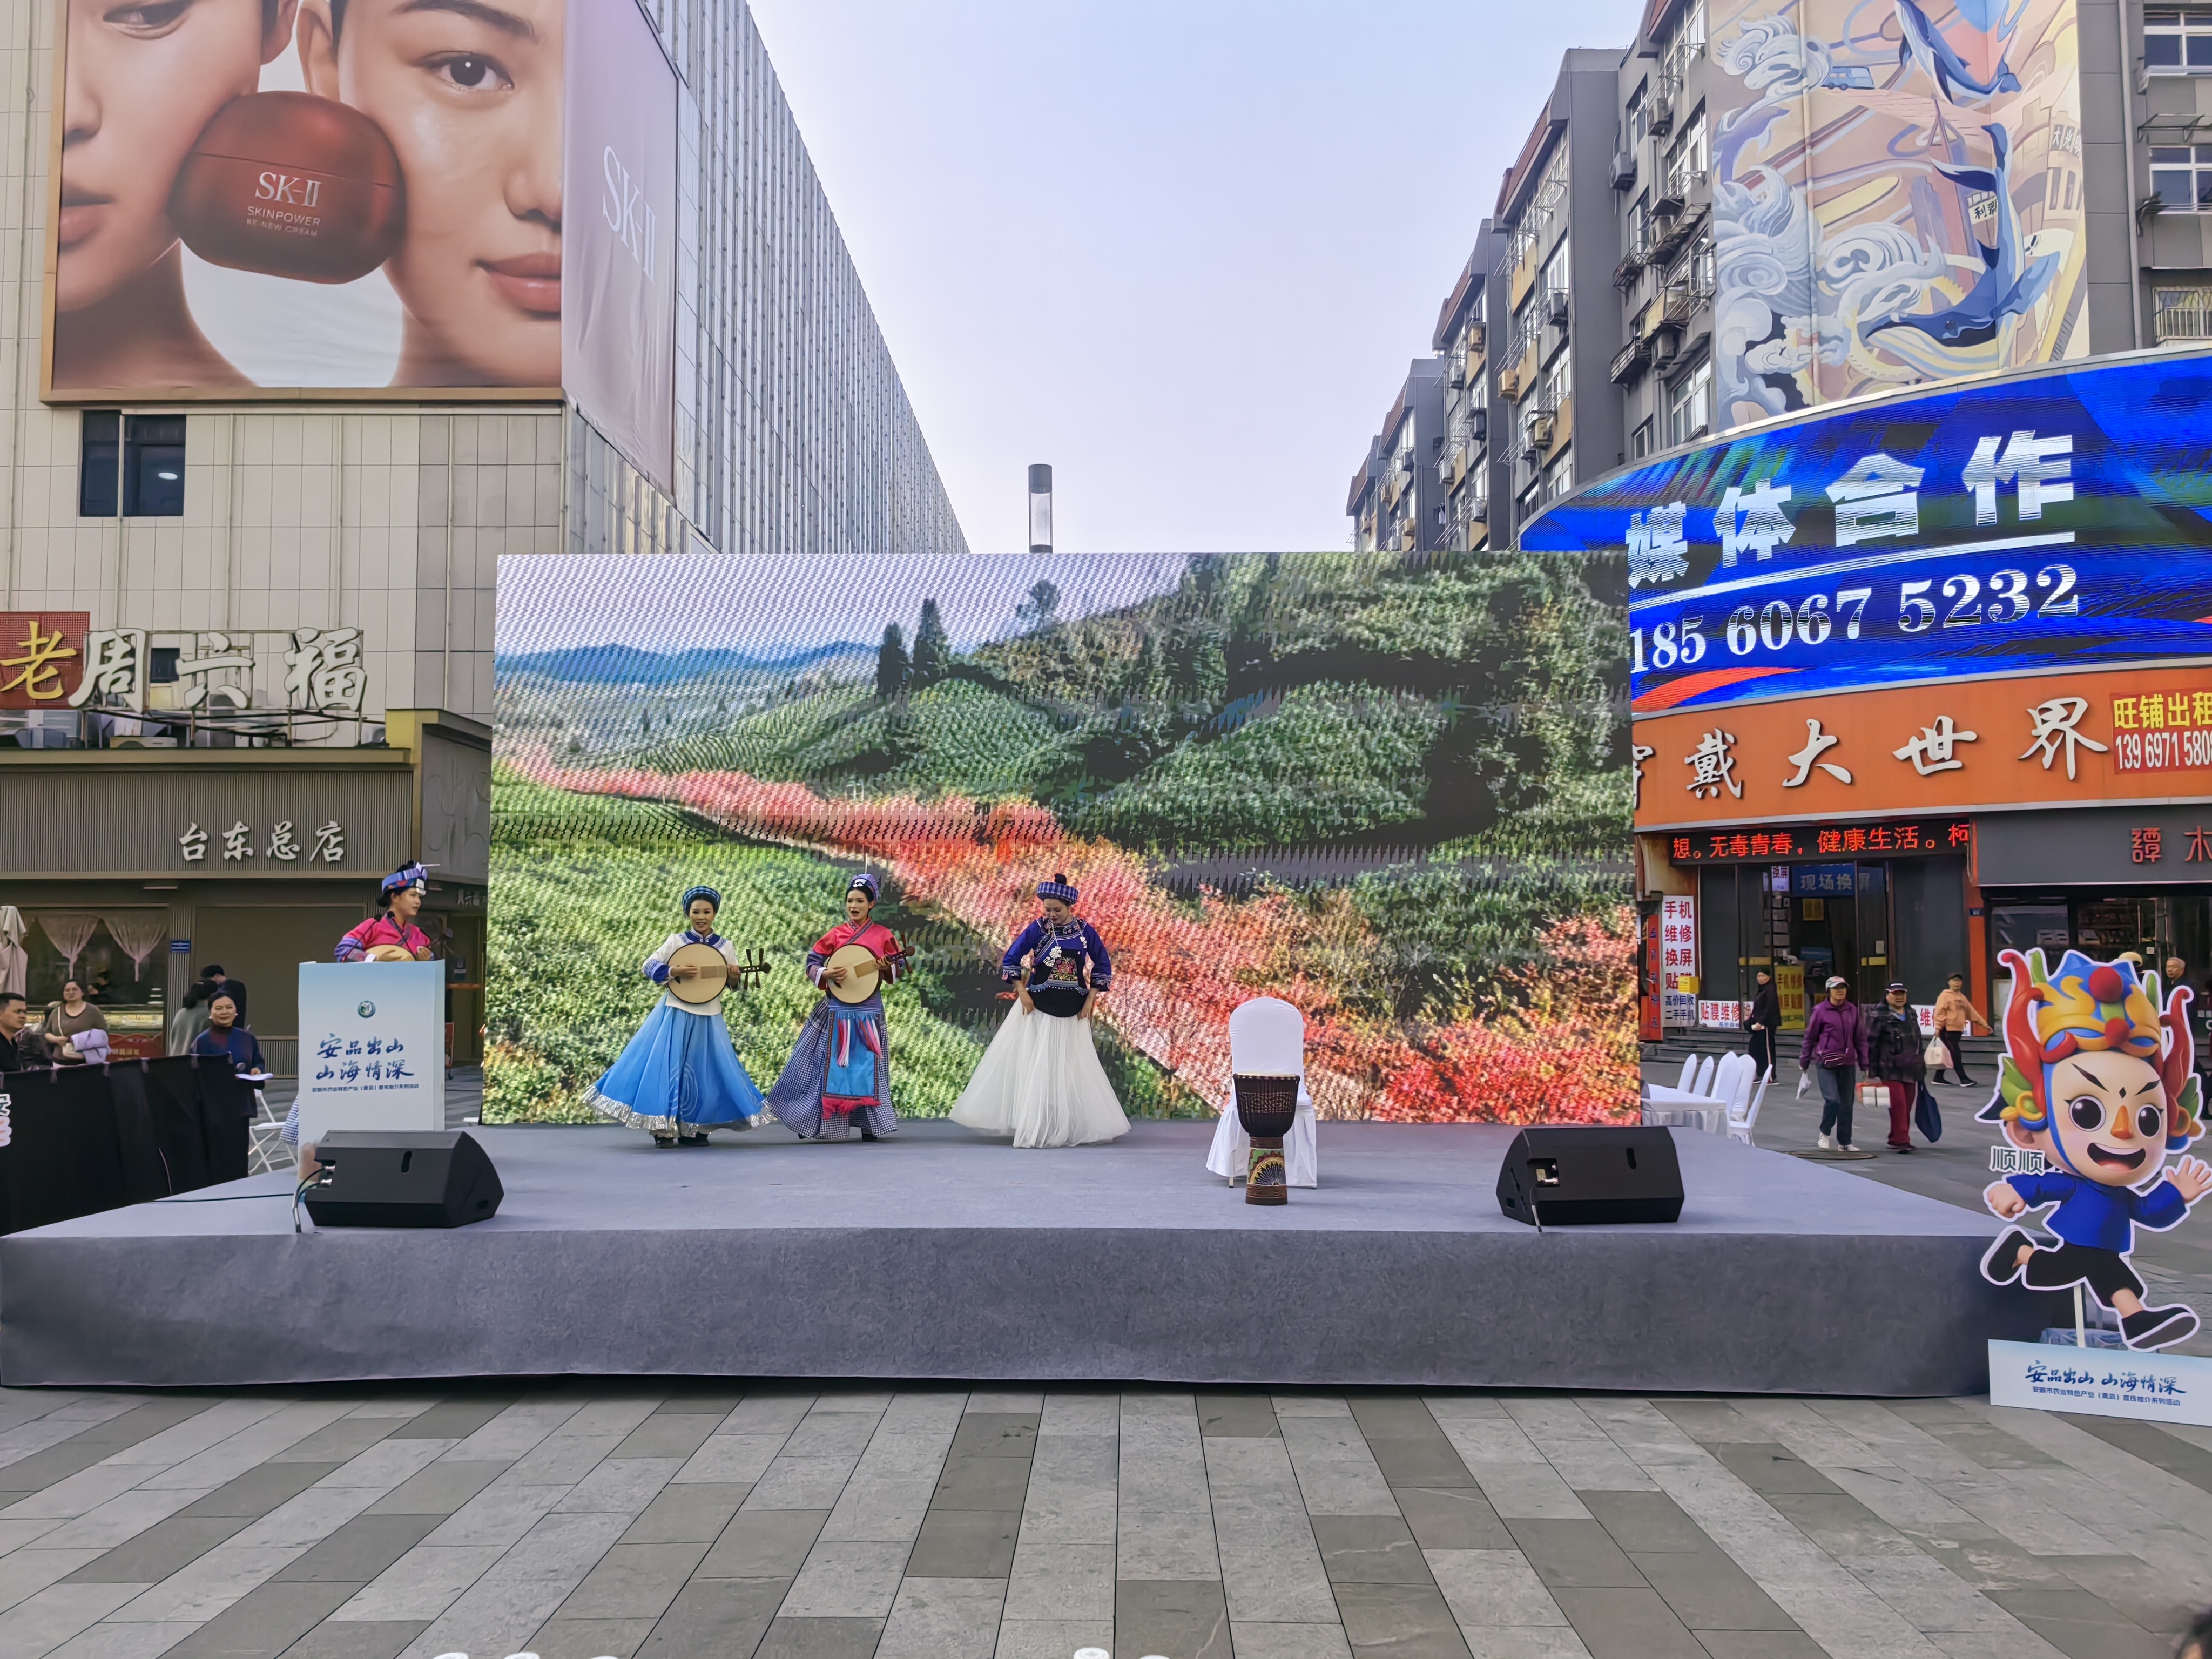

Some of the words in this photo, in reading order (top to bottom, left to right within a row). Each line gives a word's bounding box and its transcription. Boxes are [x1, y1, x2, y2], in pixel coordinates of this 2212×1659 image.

[255, 172, 322, 207] SK-II
[247, 206, 320, 227] SKINPOWER
[603, 145, 656, 286] SK-II
[1626, 430, 2074, 589] 媒体合作
[1630, 615, 1706, 674] 185
[1726, 592, 1872, 655] 6067
[1898, 564, 2078, 632] 5232
[0, 621, 77, 699] 老
[68, 627, 368, 713] 周六福
[2113, 691, 2212, 729] 旺铺出租
[2116, 734, 2141, 770] 139
[2145, 732, 2179, 768] 6971
[179, 820, 345, 862] 台东总店
[1664, 901, 1692, 919] 手机
[1664, 925, 1692, 942] 维修
[1665, 948, 1692, 967] 换屏
[1665, 972, 1692, 990] 贴
[1665, 995, 1694, 1006] 高价回收
[317, 1033, 404, 1058] 安品出山
[315, 1059, 415, 1084] 山海情深
[1992, 1148, 2044, 1174] 顺顺
[2025, 1360, 2094, 1384] 安品出山
[2101, 1371, 2187, 1395] 山海情深
